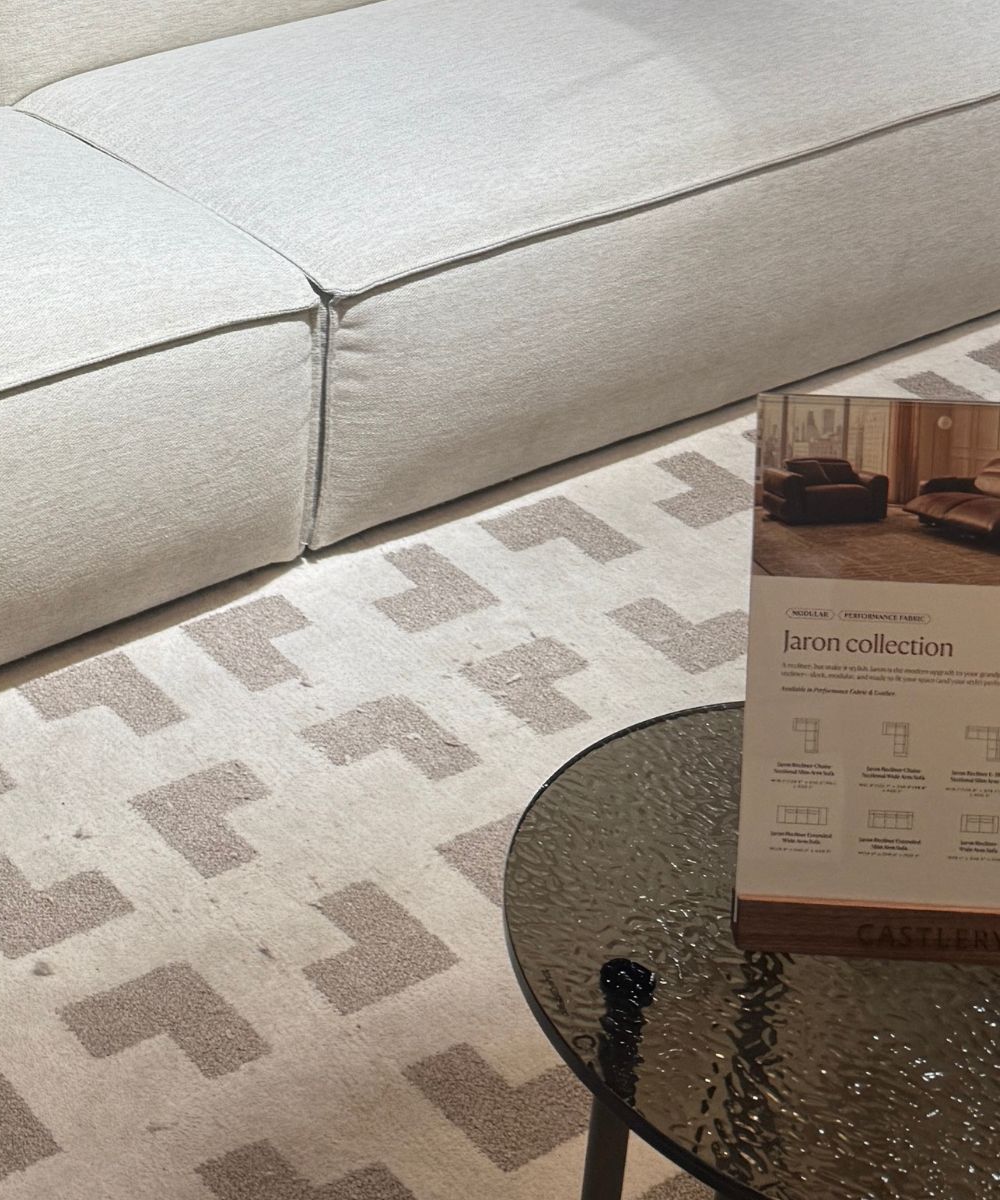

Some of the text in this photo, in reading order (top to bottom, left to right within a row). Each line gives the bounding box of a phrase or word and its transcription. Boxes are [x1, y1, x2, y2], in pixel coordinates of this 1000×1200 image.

[844, 612, 898, 621] PERFORMANCE
[783, 629, 953, 657] Jaron collection
